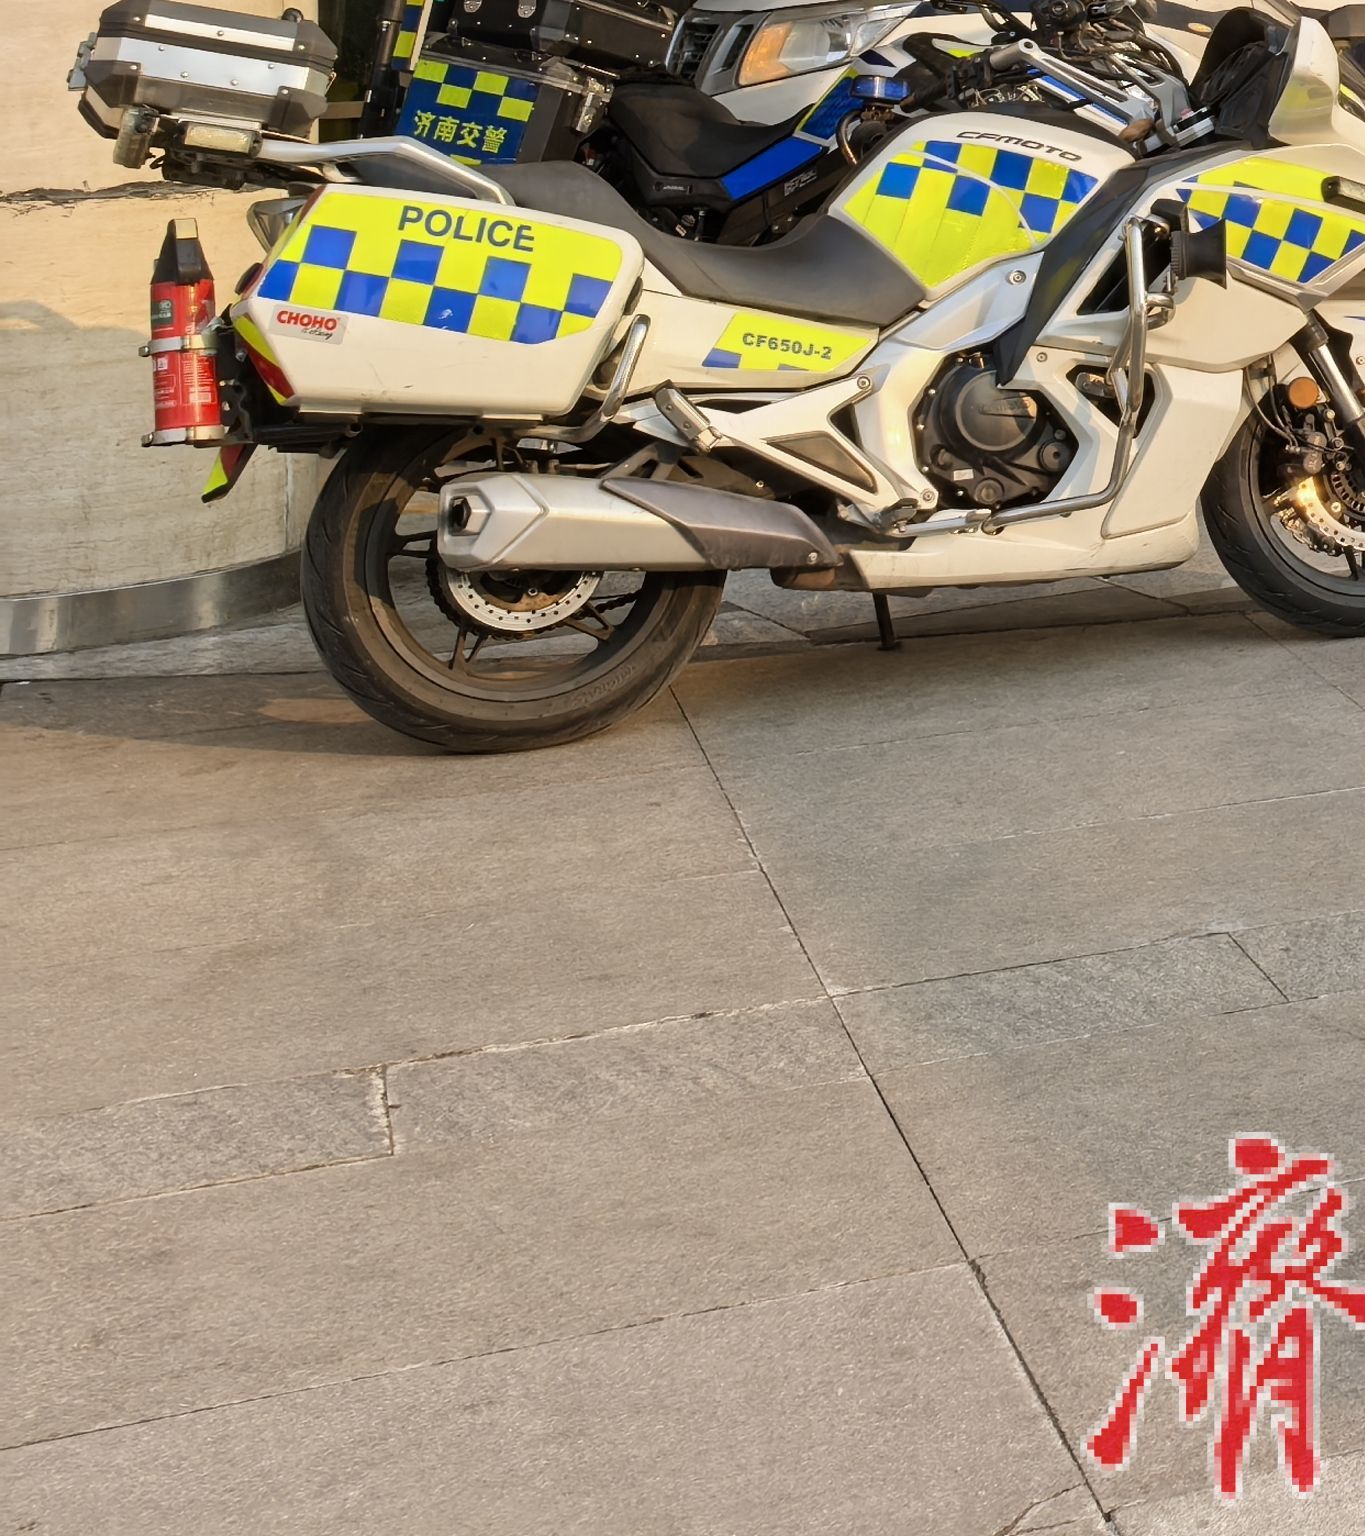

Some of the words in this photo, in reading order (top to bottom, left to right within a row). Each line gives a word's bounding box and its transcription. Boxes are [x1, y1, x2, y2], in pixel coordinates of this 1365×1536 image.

[415, 109, 508, 154] 济南交警
[956, 131, 1082, 162] CFMOTO
[398, 205, 535, 252] POLICE
[277, 310, 337, 331] CHOHO
[742, 332, 833, 360] CF650J-2
